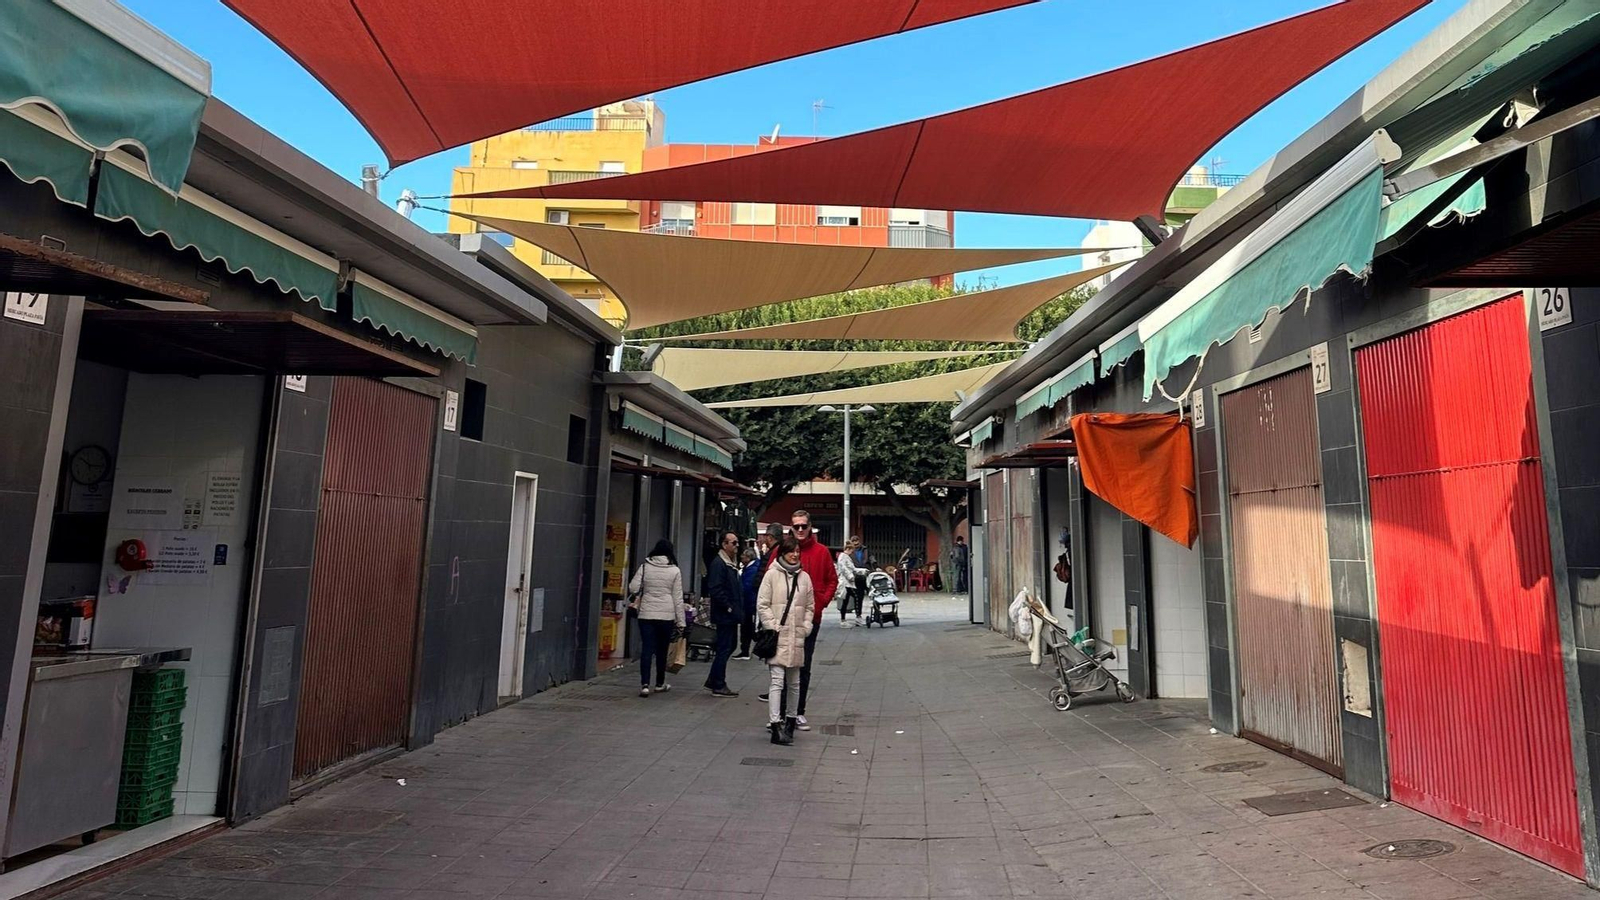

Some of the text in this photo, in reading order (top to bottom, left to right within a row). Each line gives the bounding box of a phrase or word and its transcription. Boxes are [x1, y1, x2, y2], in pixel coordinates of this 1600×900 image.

[1541, 288, 1563, 316] 26
[1316, 362, 1326, 384] 27
[447, 407, 455, 422] 17
